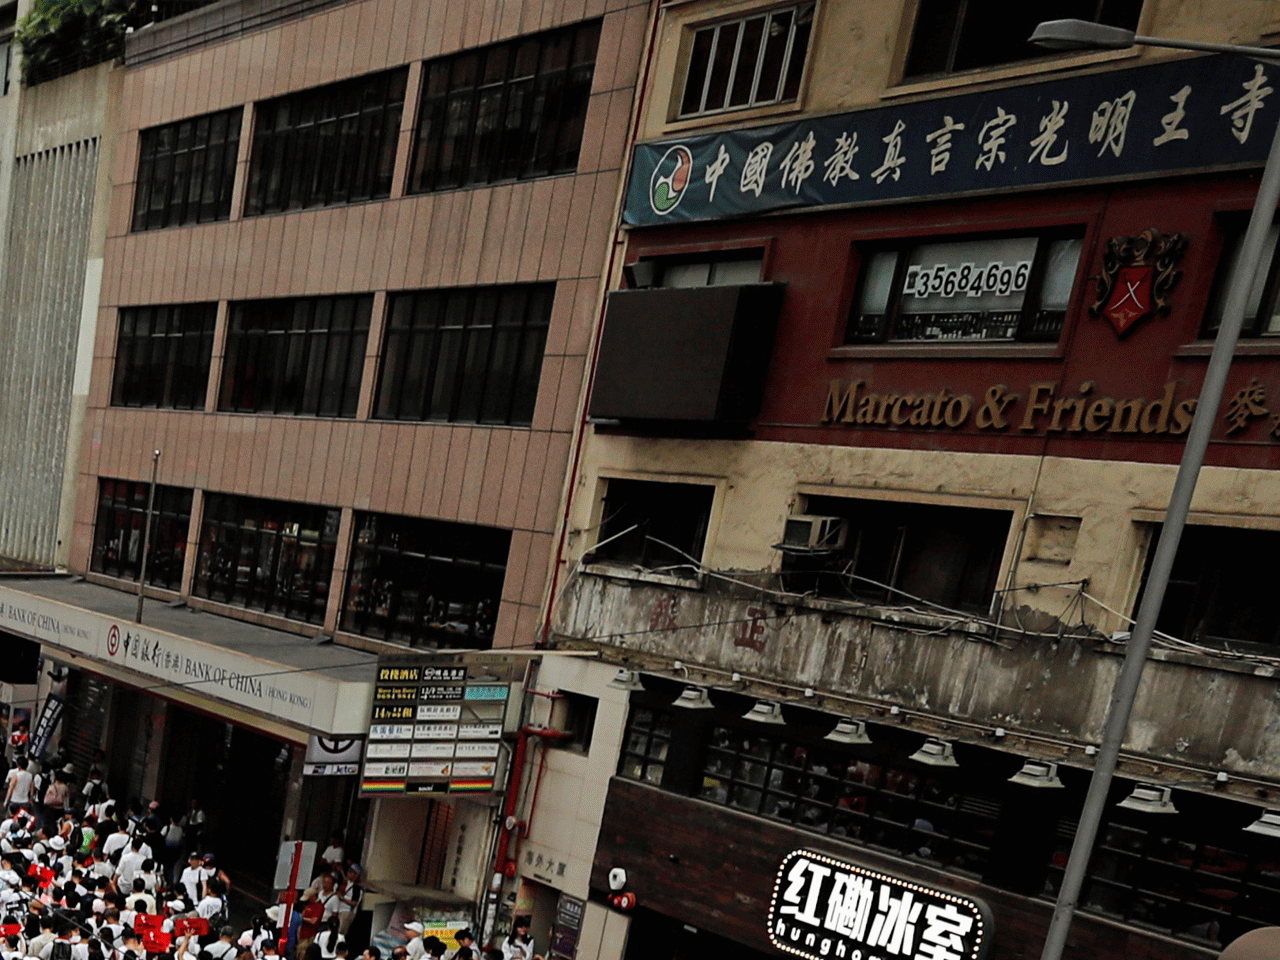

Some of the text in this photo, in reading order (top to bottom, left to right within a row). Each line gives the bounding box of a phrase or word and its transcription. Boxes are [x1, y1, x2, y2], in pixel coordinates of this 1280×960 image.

[917, 262, 1030, 298] 35684696
[820, 378, 1198, 435] Marcato & Friends
[185, 658, 212, 682] BANK
[214, 668, 225, 686] OF
[229, 672, 262, 698] CHINA
